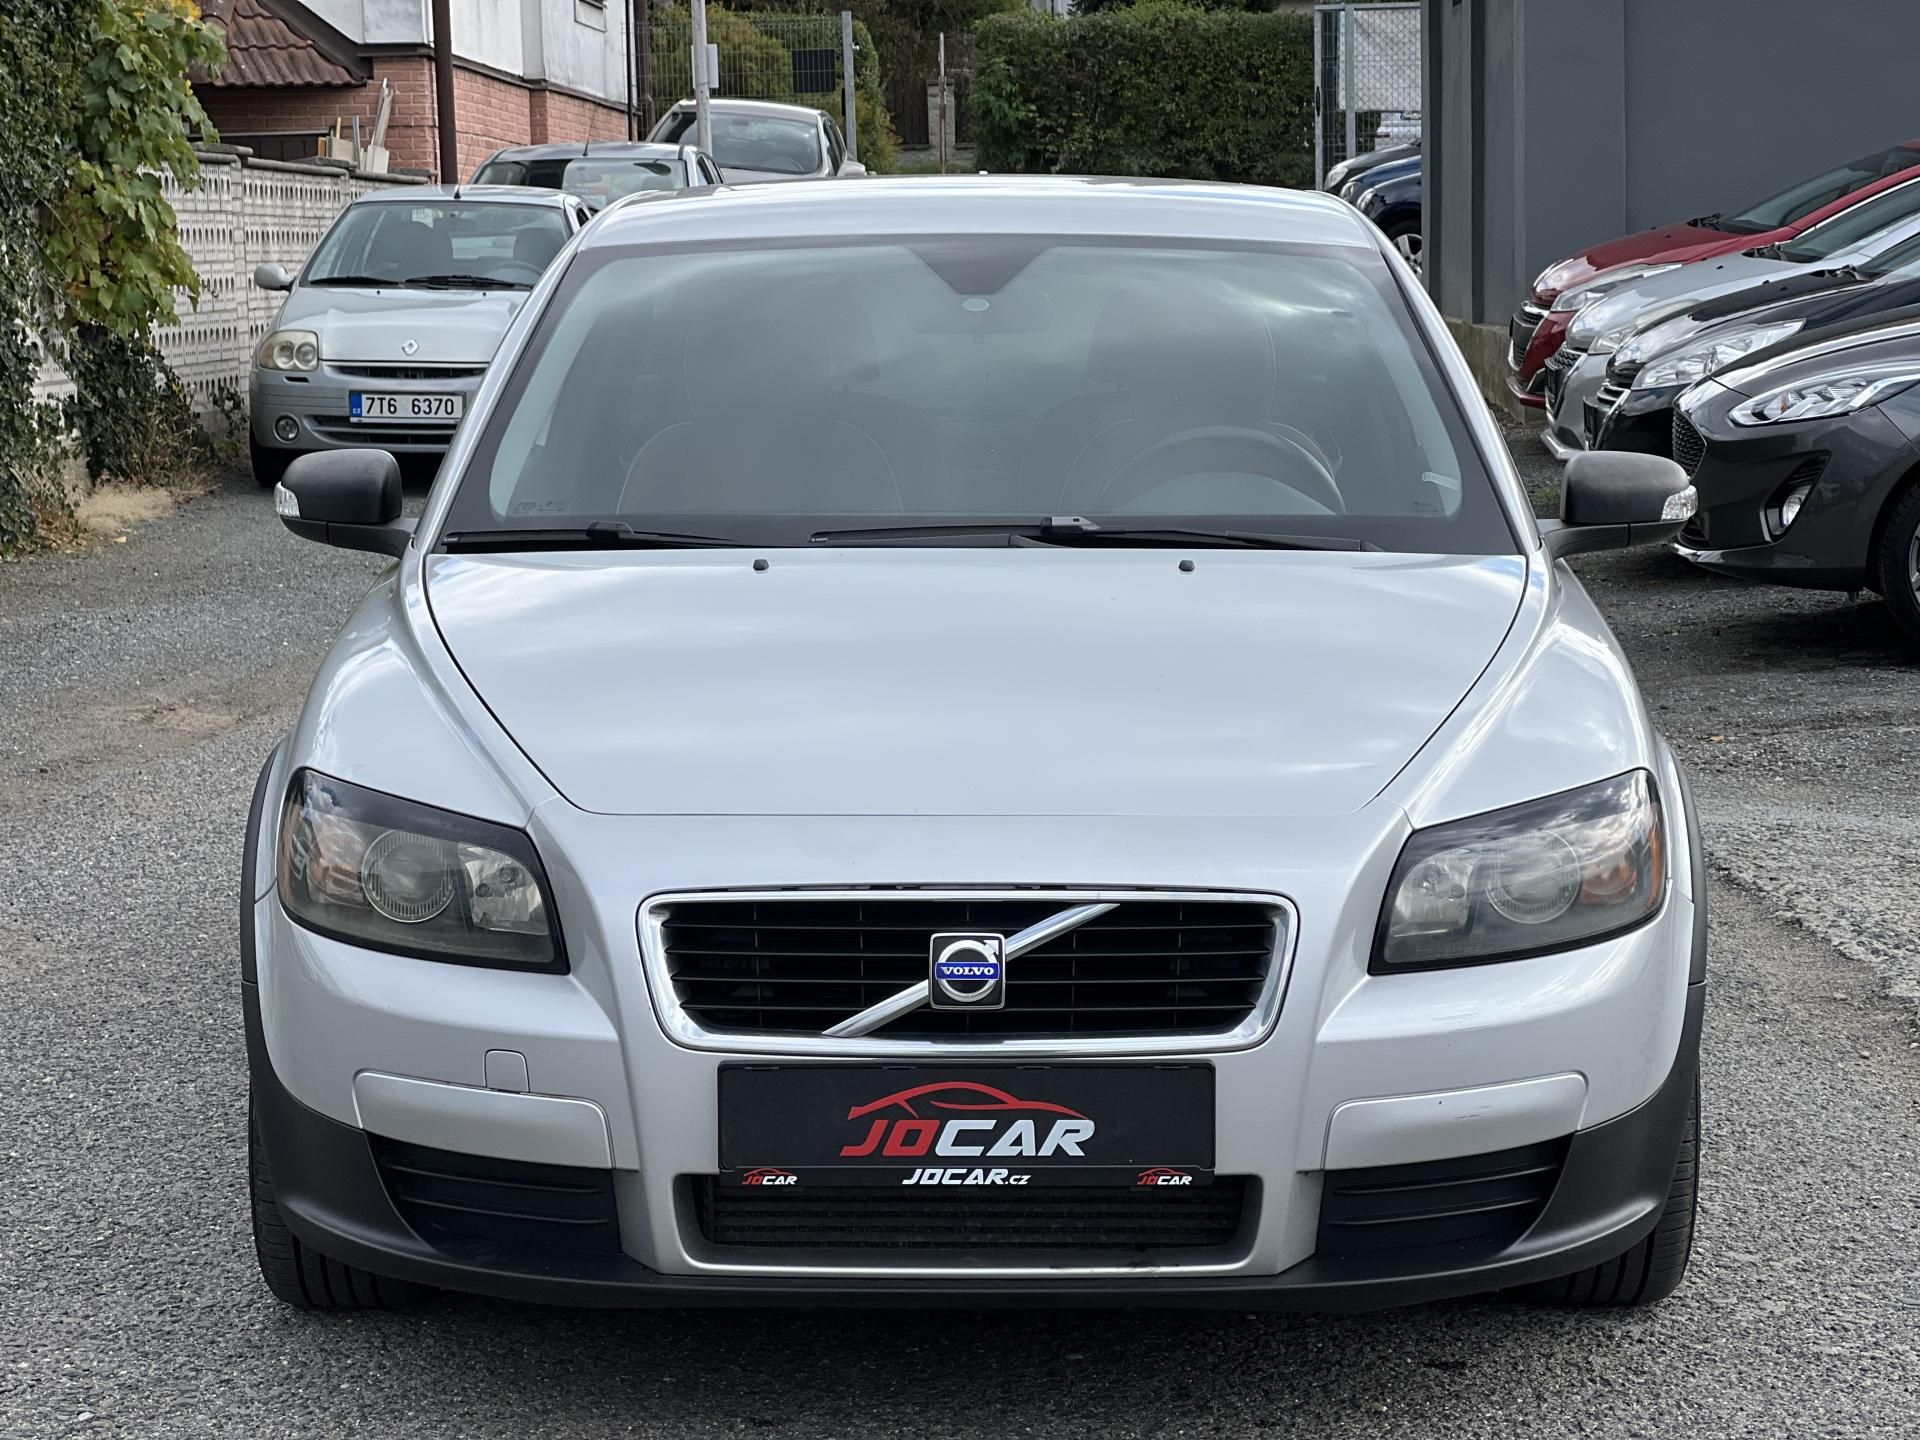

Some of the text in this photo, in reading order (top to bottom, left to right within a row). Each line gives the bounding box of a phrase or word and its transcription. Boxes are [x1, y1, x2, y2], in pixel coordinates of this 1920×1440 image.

[366, 397, 454, 415] 7T6 6370
[940, 967, 994, 975] VOLVO
[839, 1119, 1096, 1157] JOCAR
[742, 1175, 798, 1185] JOCAR
[1137, 1175, 1193, 1185] JOCAR
